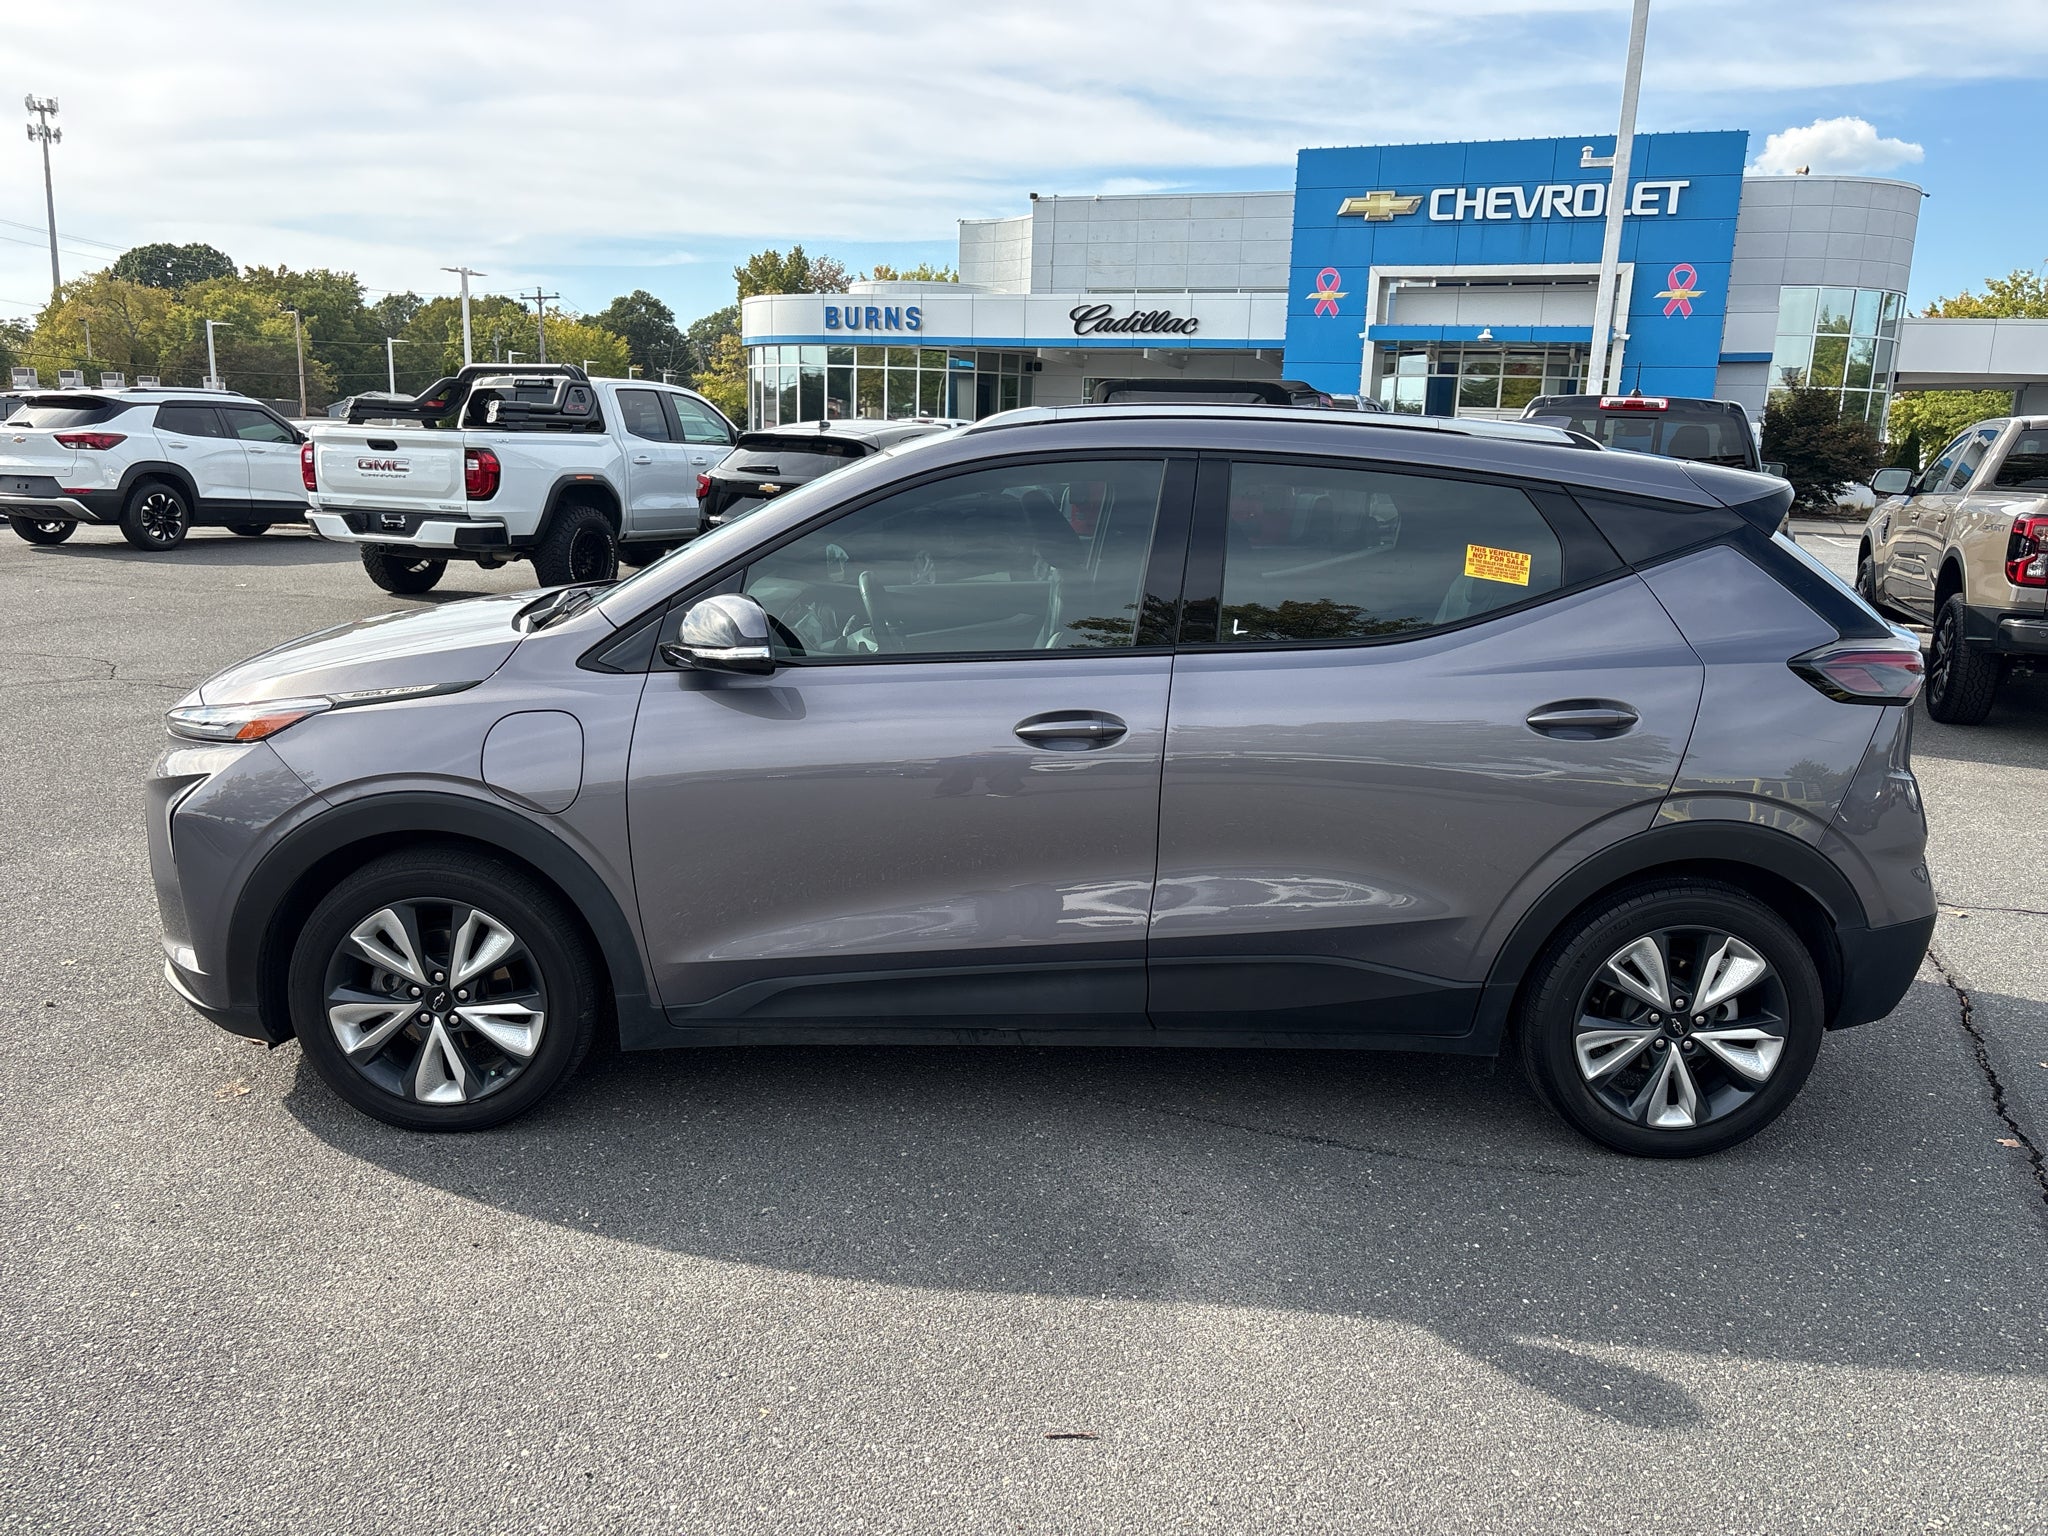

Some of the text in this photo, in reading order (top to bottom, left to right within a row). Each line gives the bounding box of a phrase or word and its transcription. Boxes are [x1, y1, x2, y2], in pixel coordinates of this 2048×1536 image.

[825, 306, 921, 331] BURNS
[1069, 303, 1199, 336] Cadillac
[357, 458, 409, 472] GMC
[1489, 549, 1519, 559] VEHICLE
[1489, 555, 1504, 563] FOR
[1506, 558, 1525, 566] SALE
